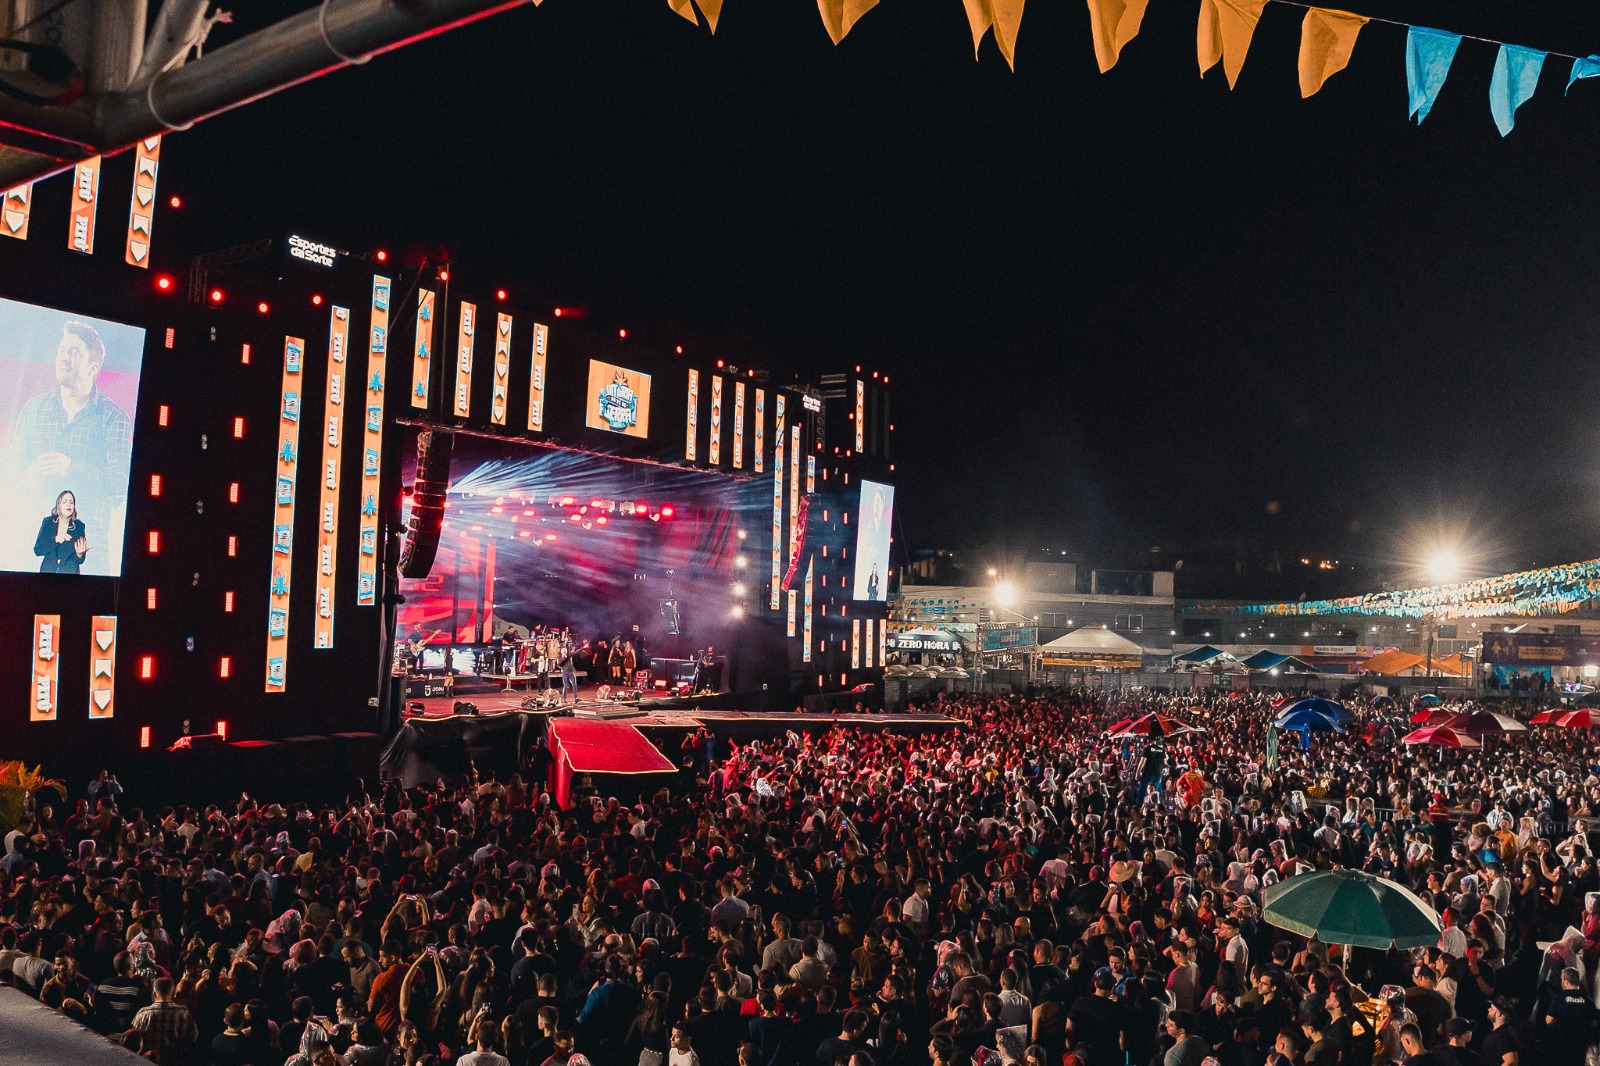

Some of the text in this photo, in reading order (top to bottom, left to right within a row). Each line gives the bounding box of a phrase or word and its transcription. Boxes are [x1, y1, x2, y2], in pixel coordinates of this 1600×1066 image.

[289, 234, 336, 257] Esportes
[304, 249, 333, 267] Sorte
[897, 639, 950, 651] ZERO HORA
[1565, 996, 1585, 1004] Rush
